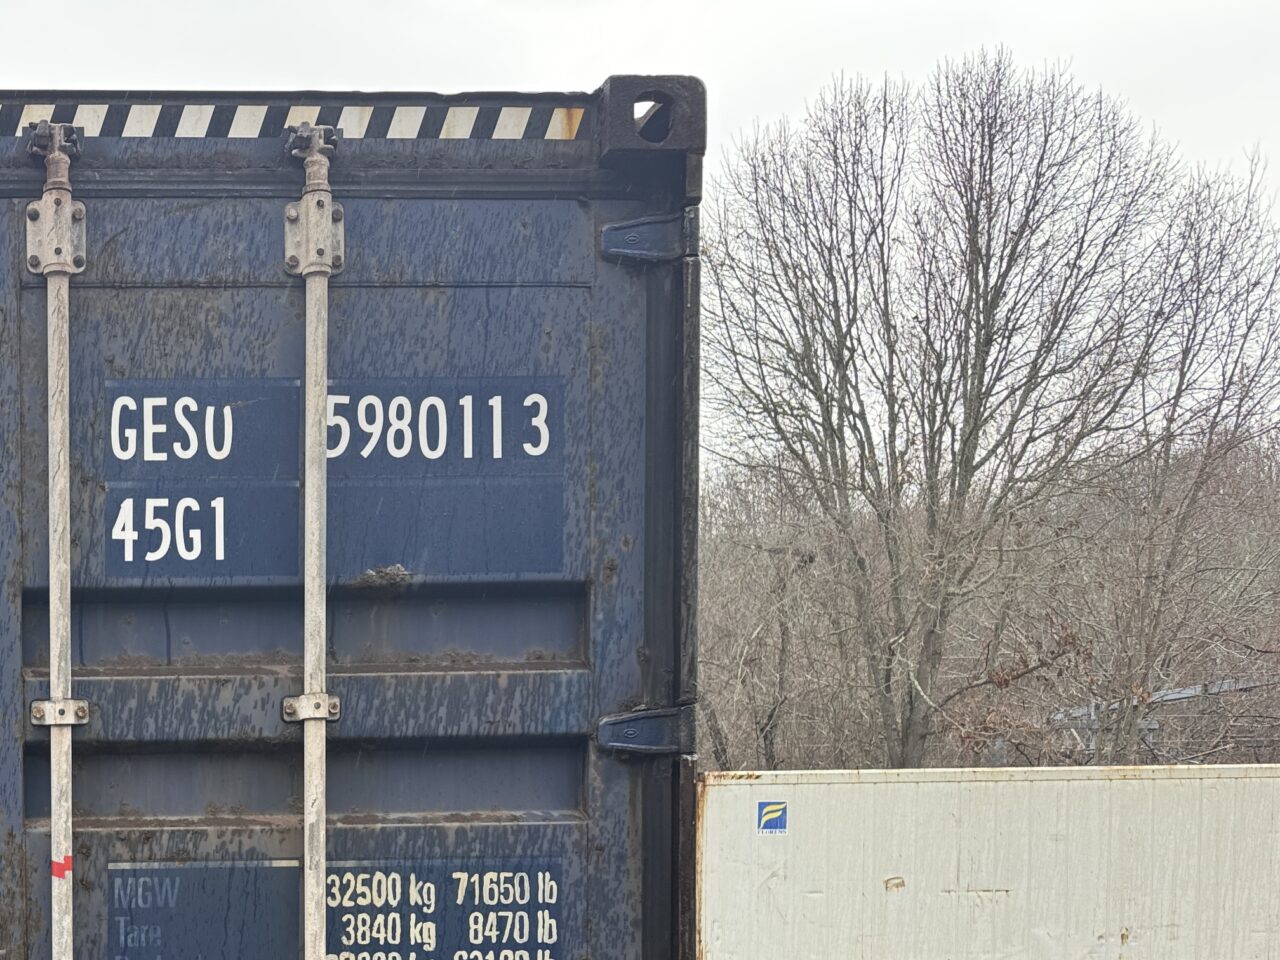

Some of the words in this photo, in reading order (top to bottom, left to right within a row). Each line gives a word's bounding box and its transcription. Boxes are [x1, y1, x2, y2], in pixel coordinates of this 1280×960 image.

[110, 396, 233, 461] GESU
[111, 497, 225, 562] 45G1
[114, 876, 181, 909] MGW
[326, 872, 401, 907] 32500
[409, 873, 436, 913] kg
[452, 872, 530, 906] 71650
[537, 872, 558, 904] lb
[114, 916, 162, 948] Tare
[341, 912, 401, 945] 3840
[410, 912, 437, 951] kg
[468, 911, 529, 944] 8470
[537, 910, 558, 944] lb
